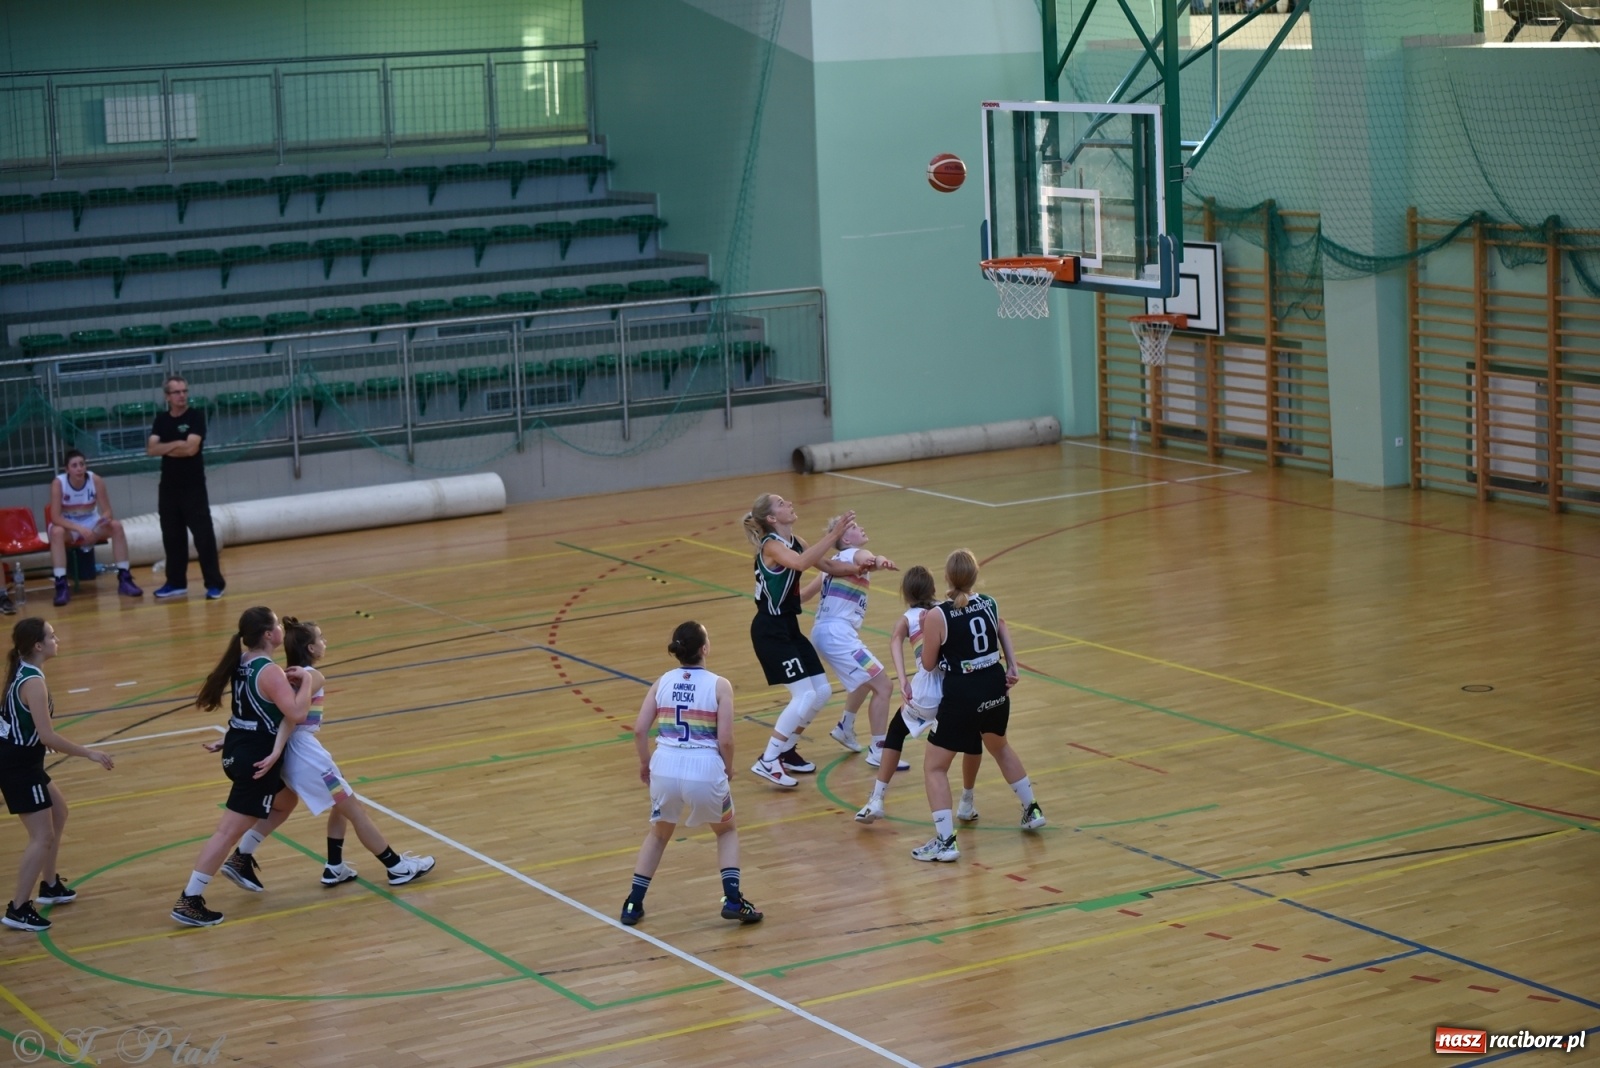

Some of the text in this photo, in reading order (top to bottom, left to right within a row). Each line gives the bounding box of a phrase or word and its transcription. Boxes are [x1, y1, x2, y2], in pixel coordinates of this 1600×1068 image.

[969, 616, 989, 654] 8
[782, 657, 804, 678] 27
[672, 691, 695, 703] POLSKA
[673, 682, 696, 692] KAMIENICA
[676, 704, 690, 742] 5
[31, 783, 46, 805] 11
[262, 794, 273, 814] 4
